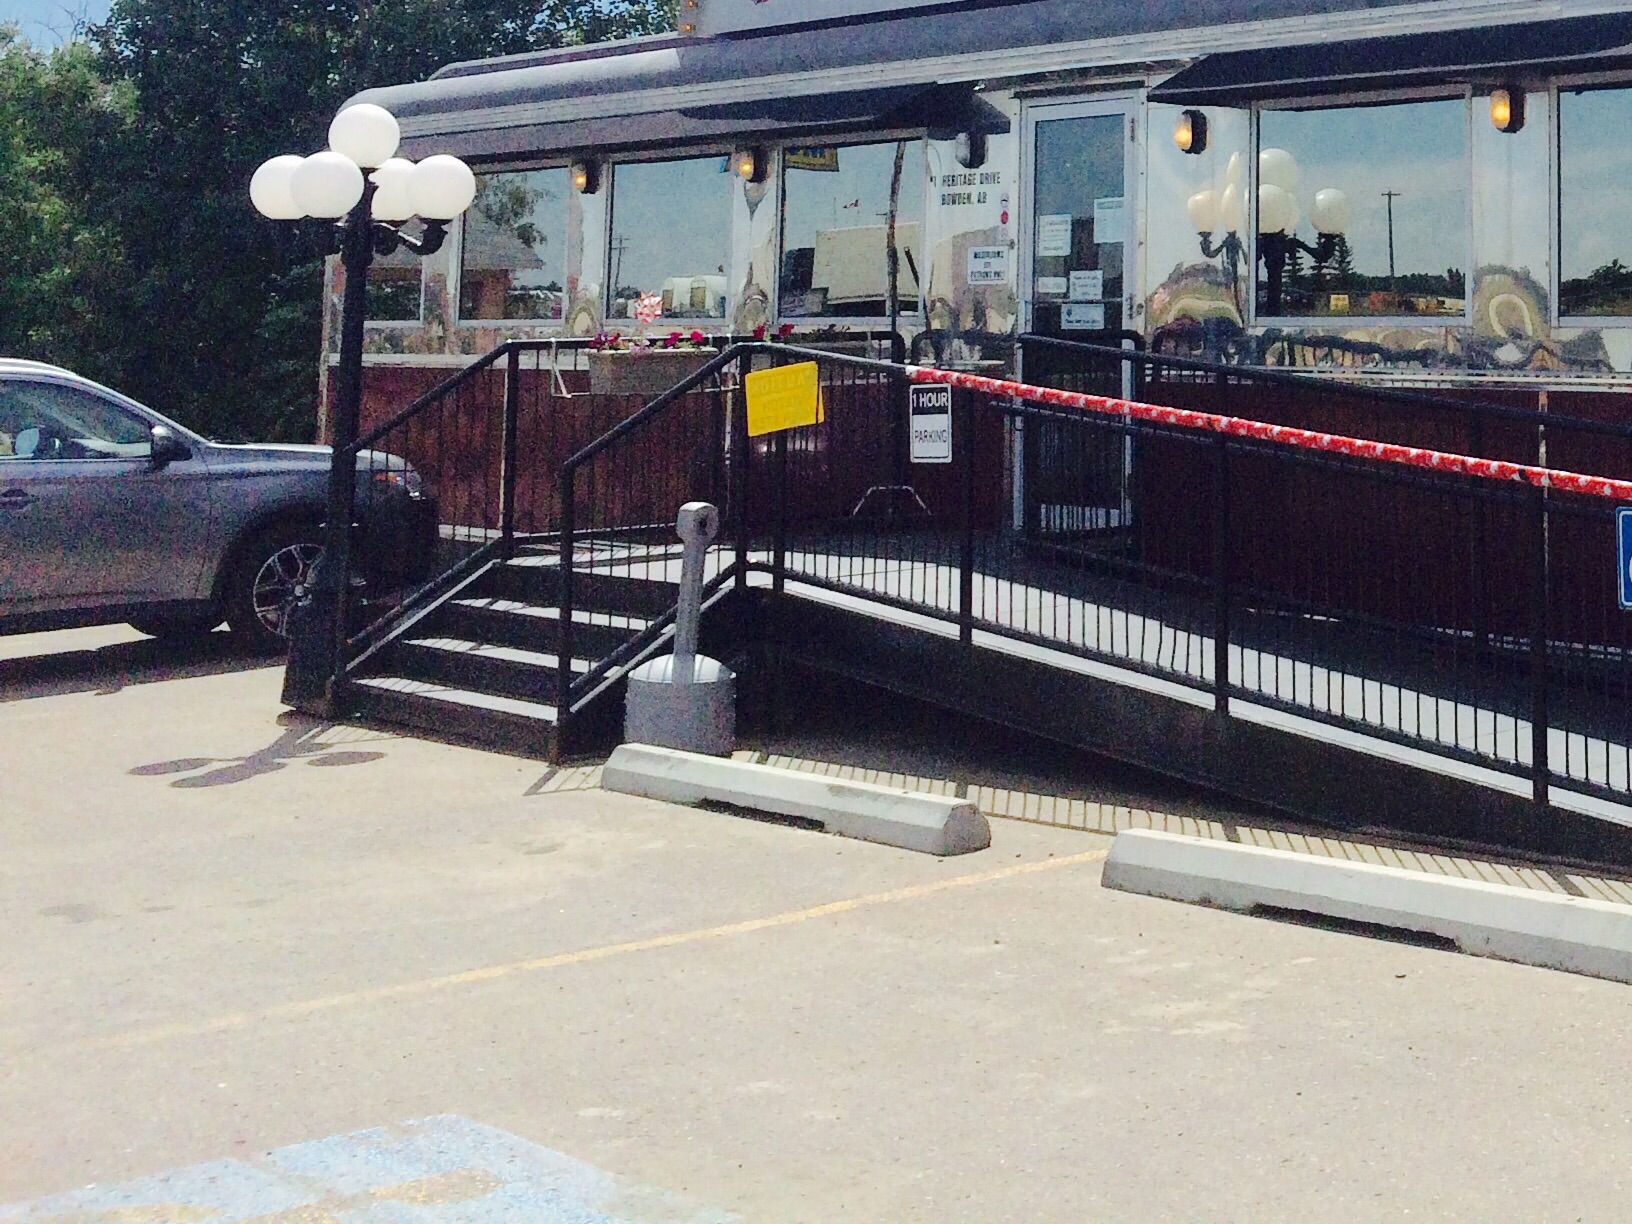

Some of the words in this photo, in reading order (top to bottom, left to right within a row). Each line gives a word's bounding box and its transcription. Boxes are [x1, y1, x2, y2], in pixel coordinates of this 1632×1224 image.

[942, 173, 976, 187] HERITAGE
[979, 172, 1001, 184] DRIVE
[912, 393, 917, 407] 1
[919, 392, 948, 407] HOUR
[914, 429, 947, 443] PARKING
